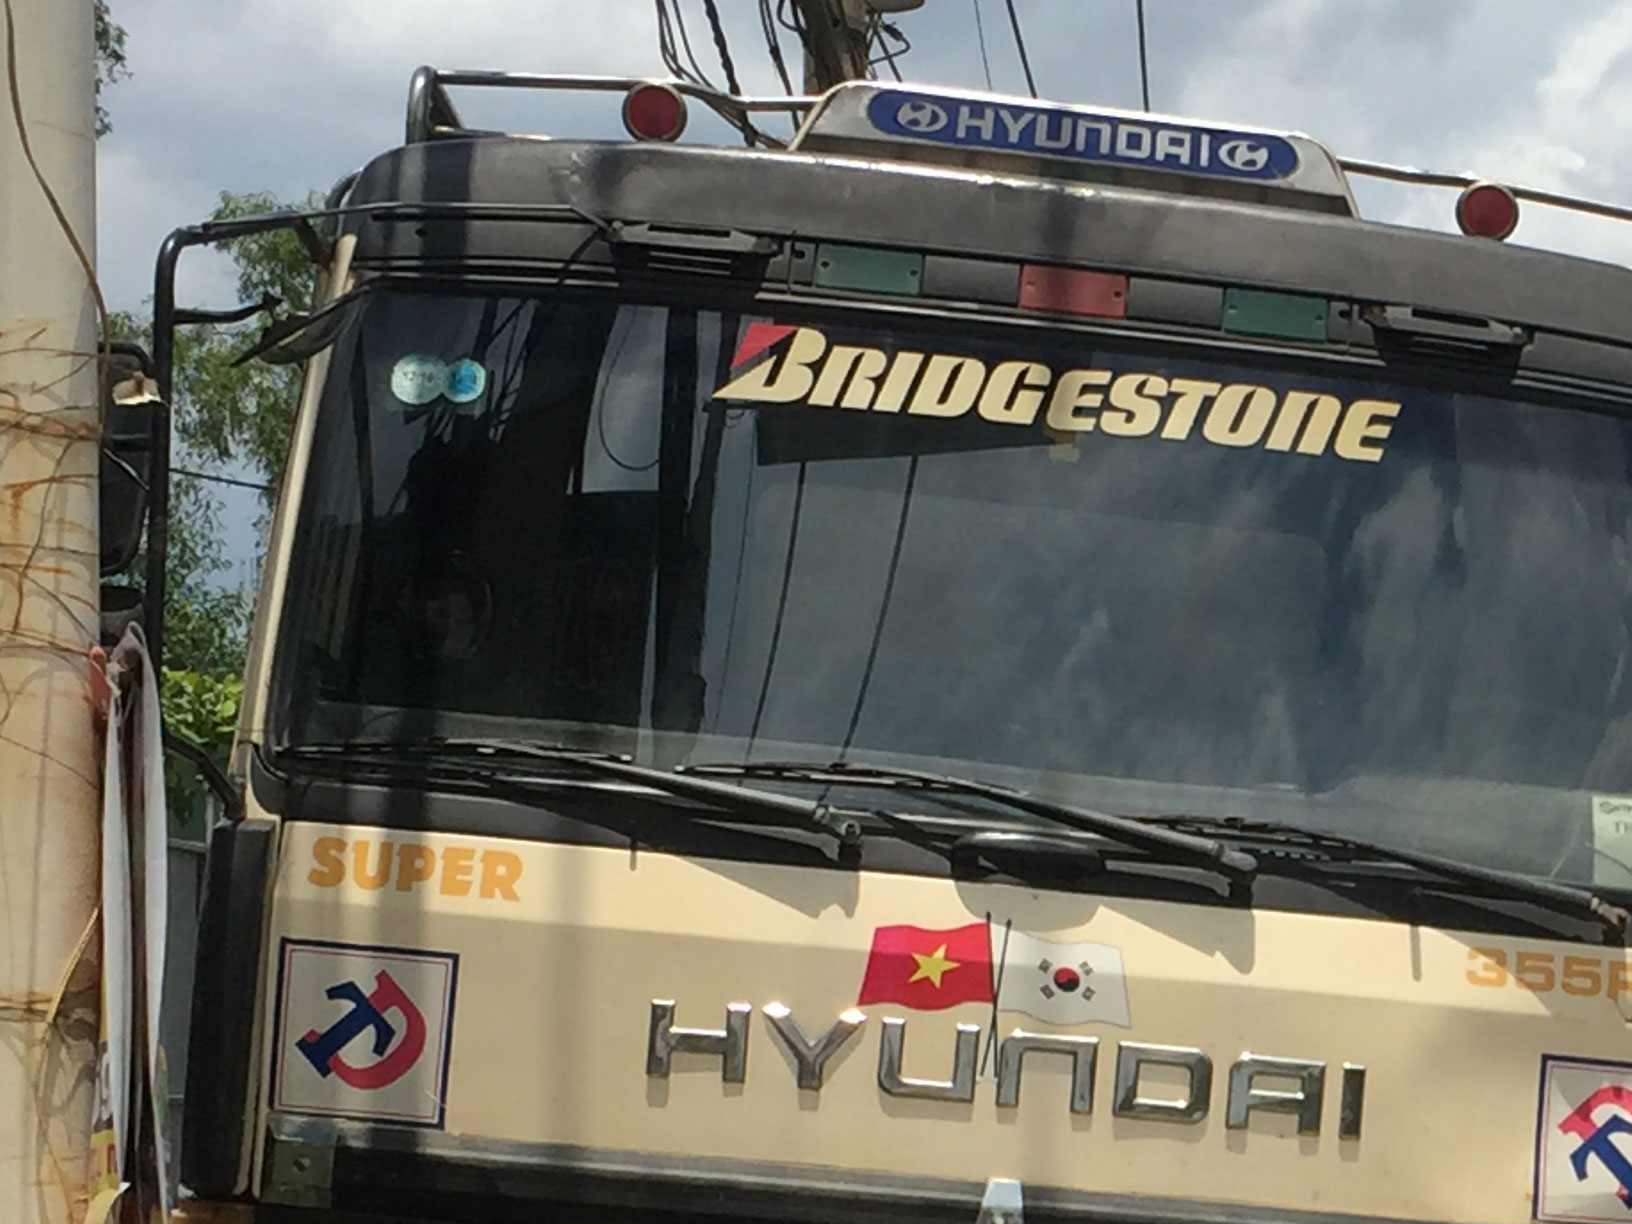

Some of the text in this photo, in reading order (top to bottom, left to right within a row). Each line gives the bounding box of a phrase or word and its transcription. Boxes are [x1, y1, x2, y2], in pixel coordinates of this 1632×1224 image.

[956, 105, 1210, 168] HYUNDAI
[712, 326, 1402, 462] BRIDGESTONE
[307, 835, 523, 902] SUPER
[645, 998, 1367, 1141] HYUNDAI
